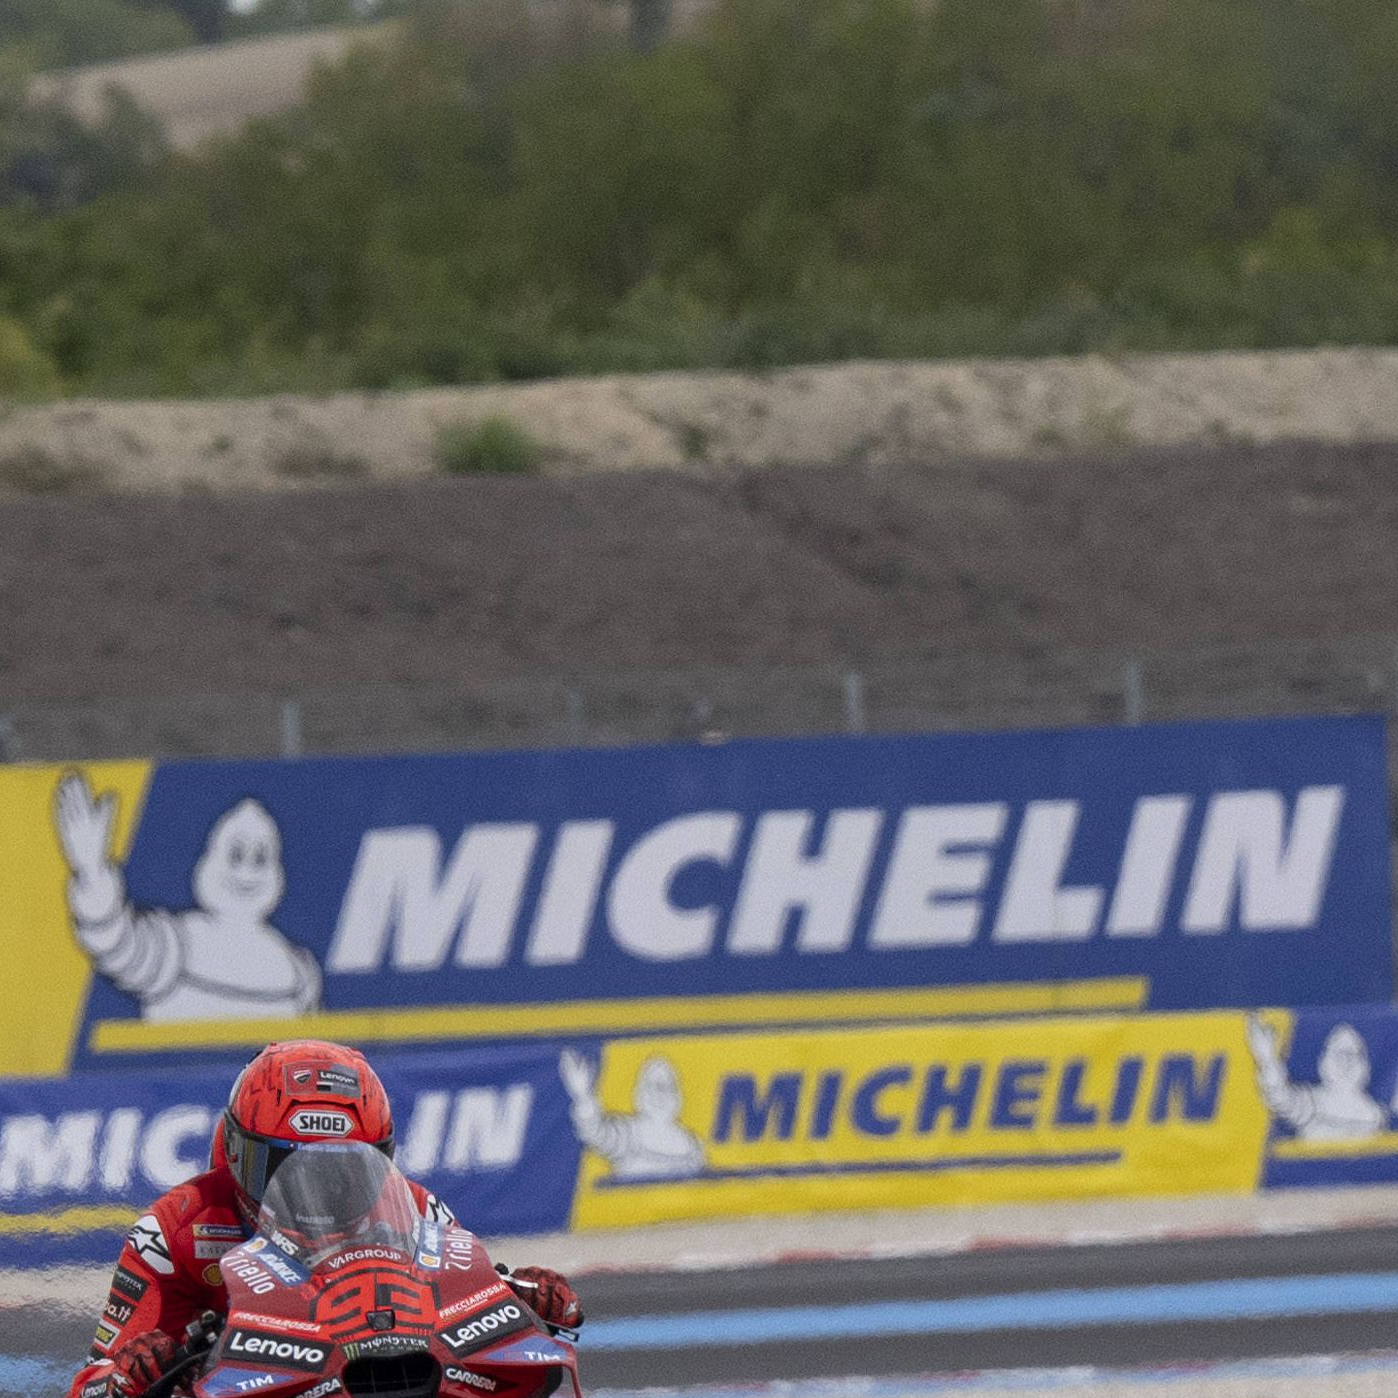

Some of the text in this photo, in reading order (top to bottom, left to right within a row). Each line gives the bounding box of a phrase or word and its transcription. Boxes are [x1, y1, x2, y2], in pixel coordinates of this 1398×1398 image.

[325, 784, 1344, 973] MICHELIN
[712, 1052, 1229, 1145] MICHELIN
[299, 1115, 345, 1132] SHOEI
[439, 1283, 507, 1320] FRECCIAROSSA
[441, 1304, 521, 1348] Lenovo
[230, 1331, 325, 1363] Lenovo
[236, 1374, 275, 1391] TIM
[446, 1367, 497, 1391] CARRERA
